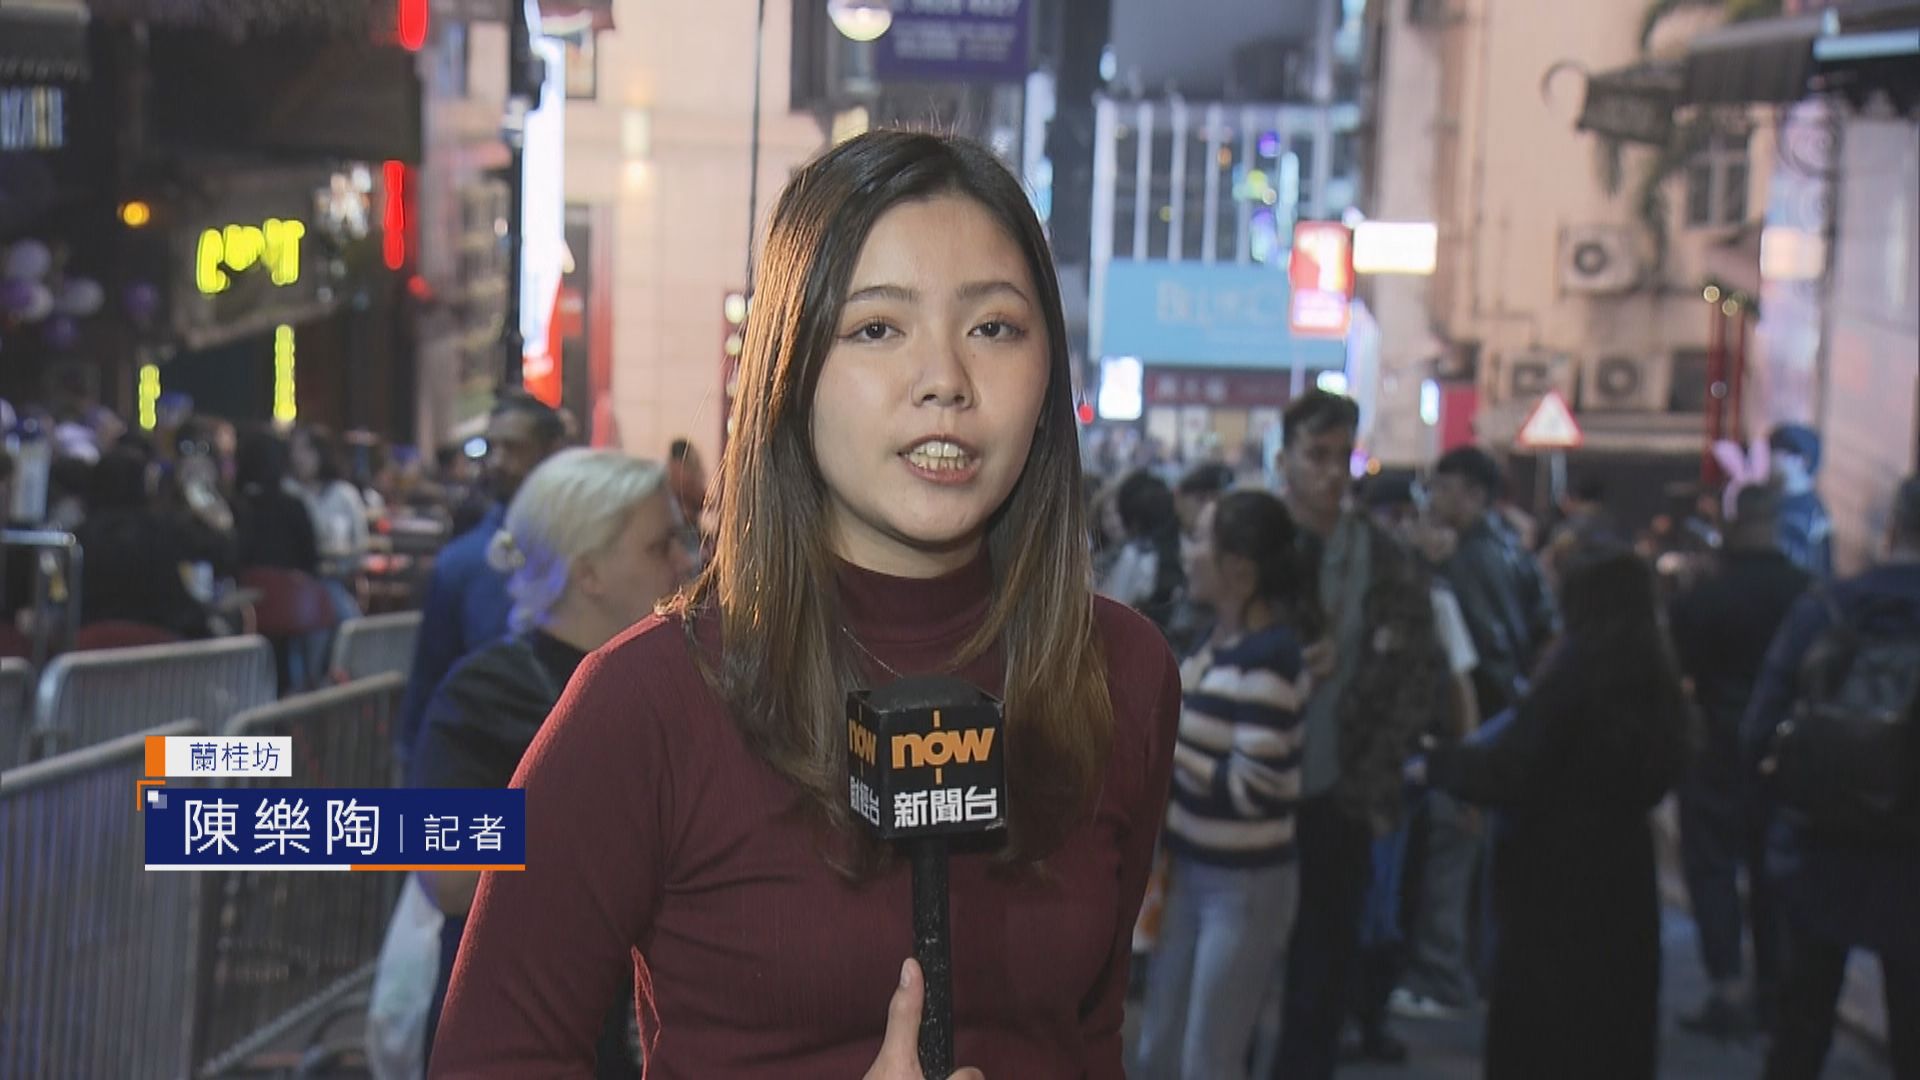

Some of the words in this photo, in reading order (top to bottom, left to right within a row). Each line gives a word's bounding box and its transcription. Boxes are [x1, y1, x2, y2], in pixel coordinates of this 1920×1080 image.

[848, 718, 877, 767] now
[891, 727, 996, 770] now
[893, 785, 998, 829] 新聞台
